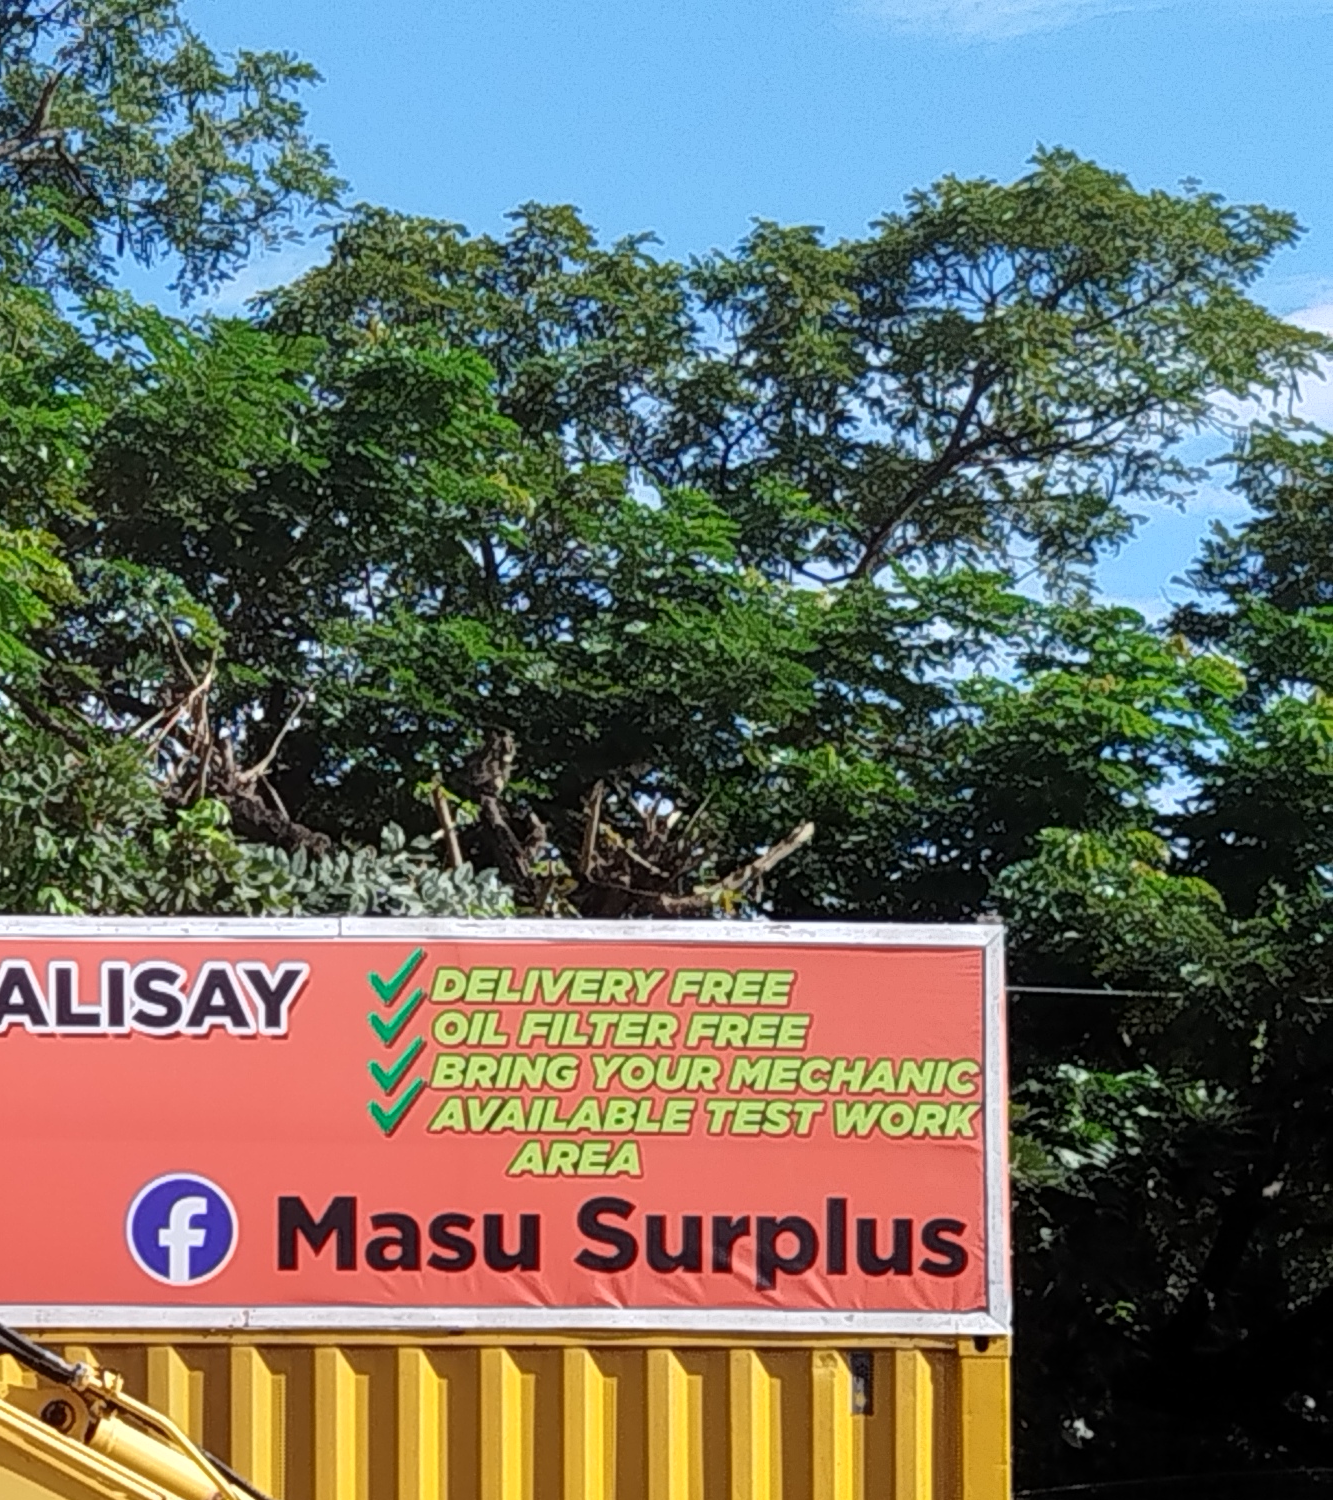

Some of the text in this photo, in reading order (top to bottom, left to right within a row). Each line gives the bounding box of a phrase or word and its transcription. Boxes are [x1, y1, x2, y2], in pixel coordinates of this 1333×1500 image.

[433, 968, 795, 1006] DELIVERY FREE
[433, 1012, 810, 1050] OIL FILTER FREE
[432, 1056, 981, 1096] BRING YOUR MECHANIC
[429, 1099, 981, 1138] AVAILABLE TEST WORK
[508, 1142, 642, 1176] AREA
[278, 1196, 968, 1289] Masu Surplus
